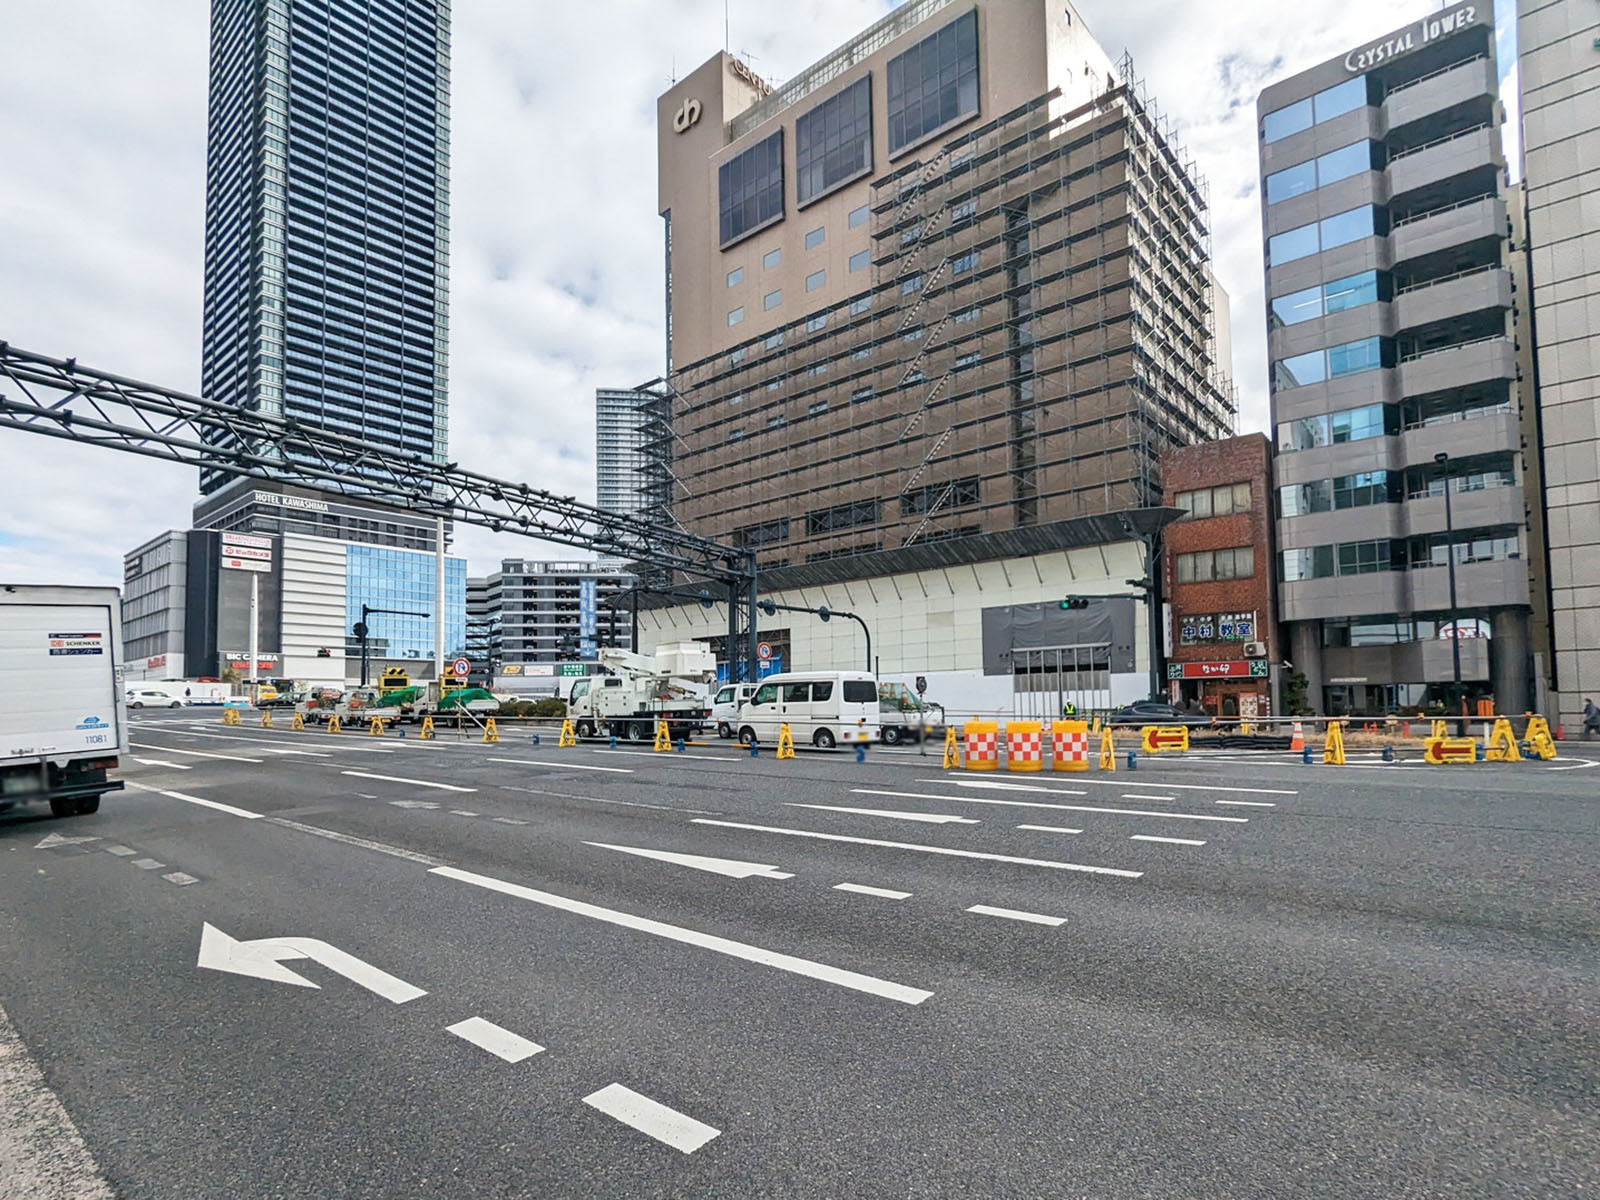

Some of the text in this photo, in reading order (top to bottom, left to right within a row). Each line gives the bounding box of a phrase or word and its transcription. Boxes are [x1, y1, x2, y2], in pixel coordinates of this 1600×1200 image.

[1344, 6, 1476, 72] CRYSTAL TOWER
[255, 492, 329, 512] HOTEL KAWASHIMA
[226, 653, 279, 662] BIC CMERA
[85, 734, 108, 744] 11081
